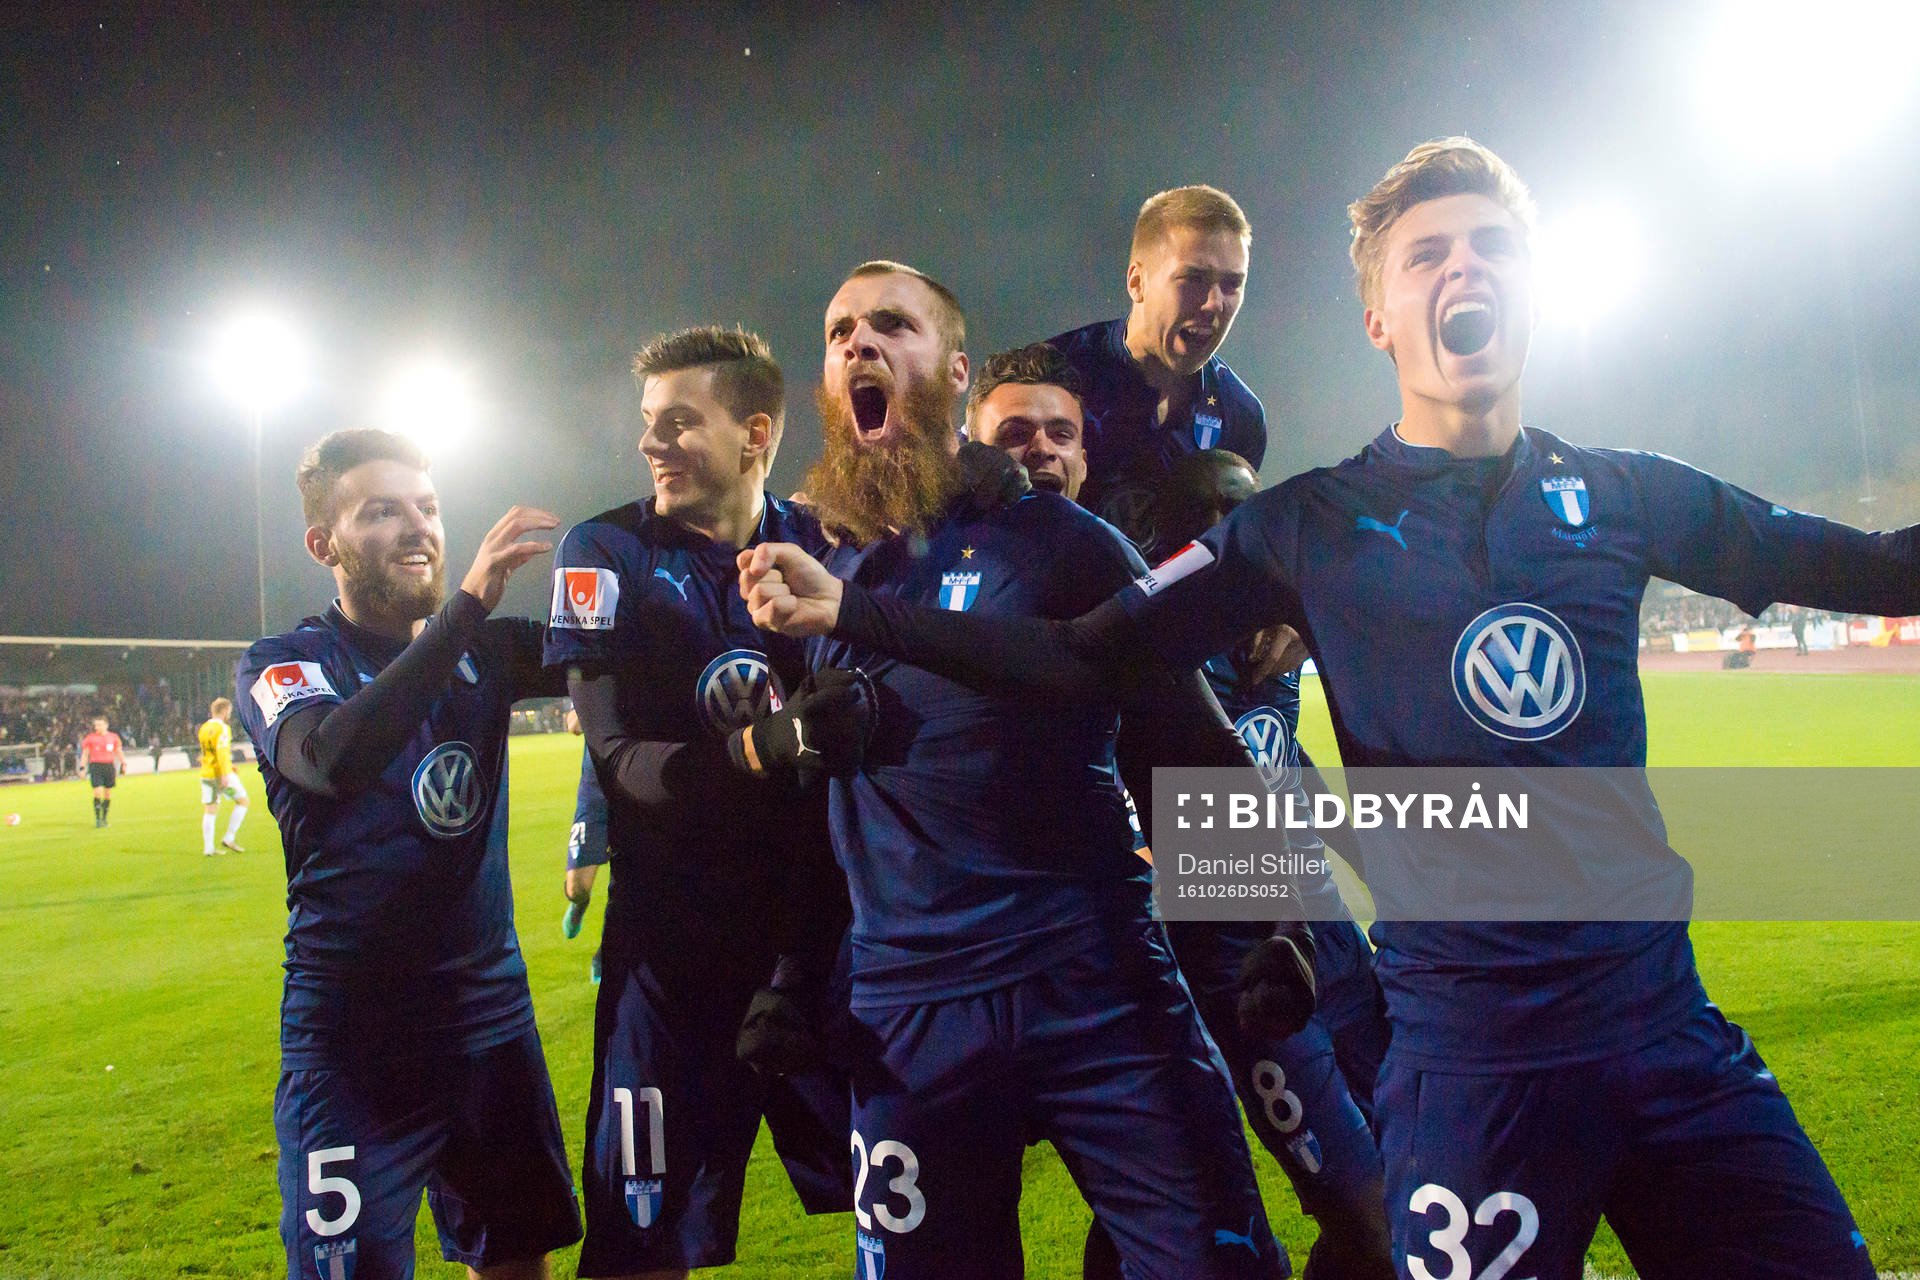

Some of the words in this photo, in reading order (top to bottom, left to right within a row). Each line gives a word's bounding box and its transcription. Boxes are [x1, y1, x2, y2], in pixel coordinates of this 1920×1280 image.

[590, 616, 612, 626] SPEL
[1465, 616, 1575, 728] VW
[569, 821, 586, 846] 21
[613, 1086, 667, 1176] 11
[1251, 1060, 1303, 1134] 8
[305, 1145, 361, 1237] 5
[850, 1129, 927, 1234] 23
[1406, 1183, 1540, 1280] 32
